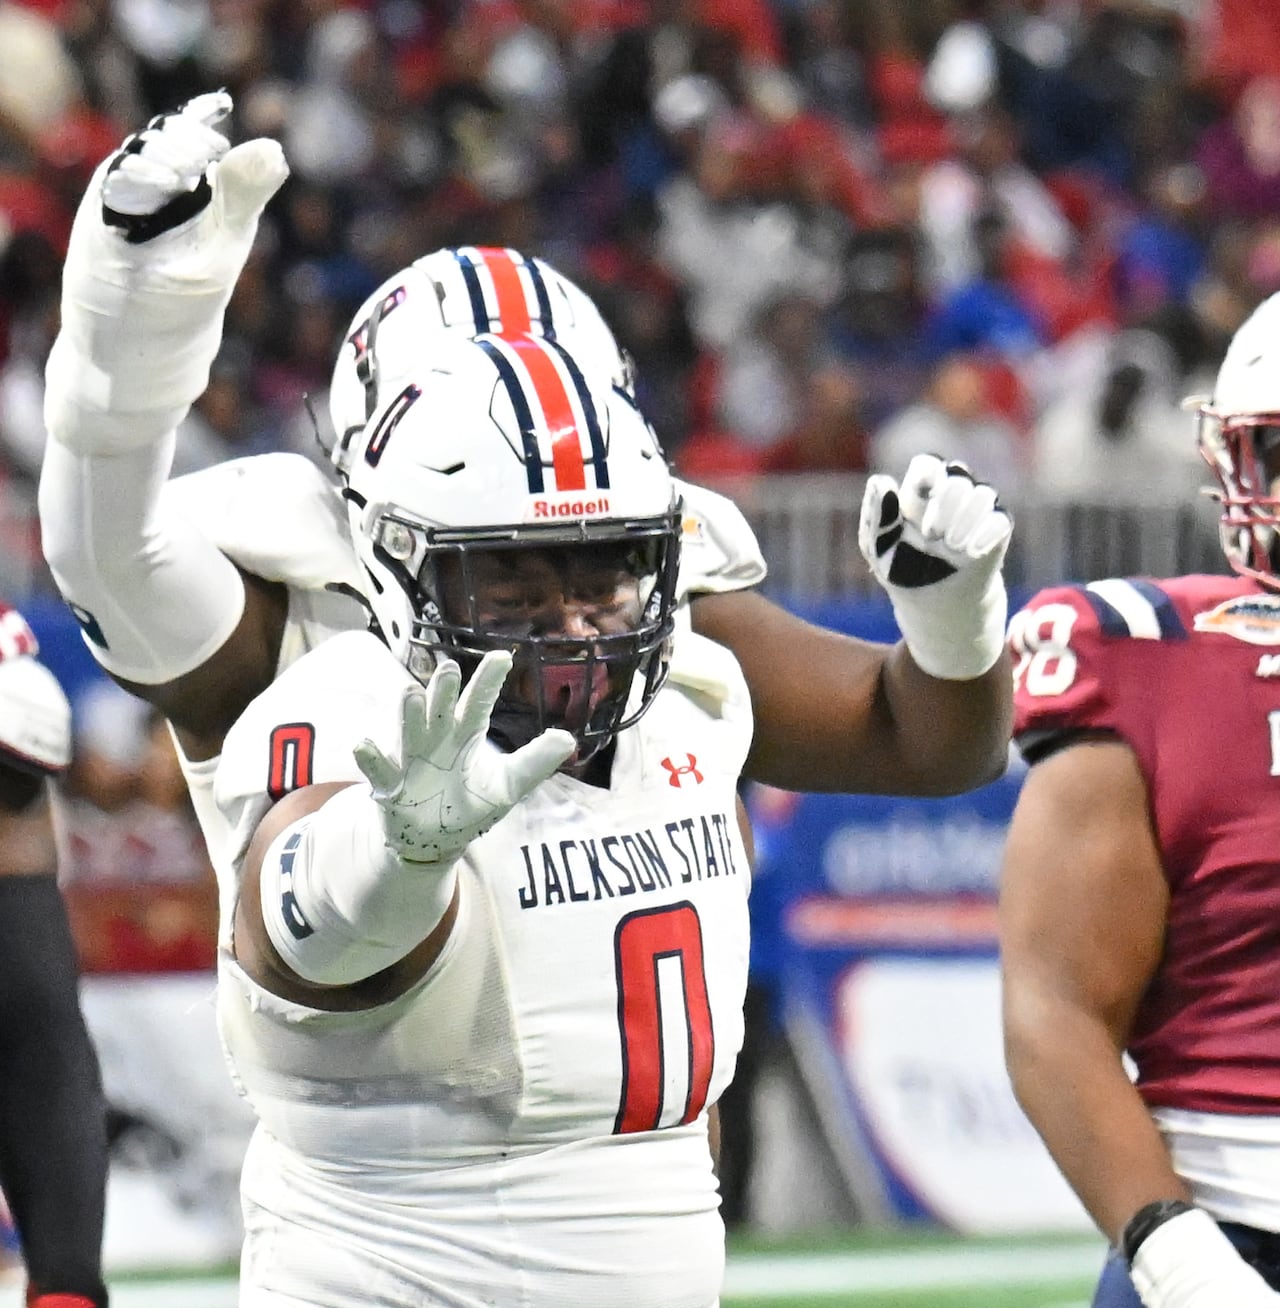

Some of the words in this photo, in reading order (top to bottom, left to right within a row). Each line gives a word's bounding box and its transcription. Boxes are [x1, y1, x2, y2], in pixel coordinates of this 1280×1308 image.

[533, 497, 610, 519] Riddell
[267, 722, 316, 803] 0
[519, 827, 673, 910] JACKSON
[612, 900, 715, 1136] 0
